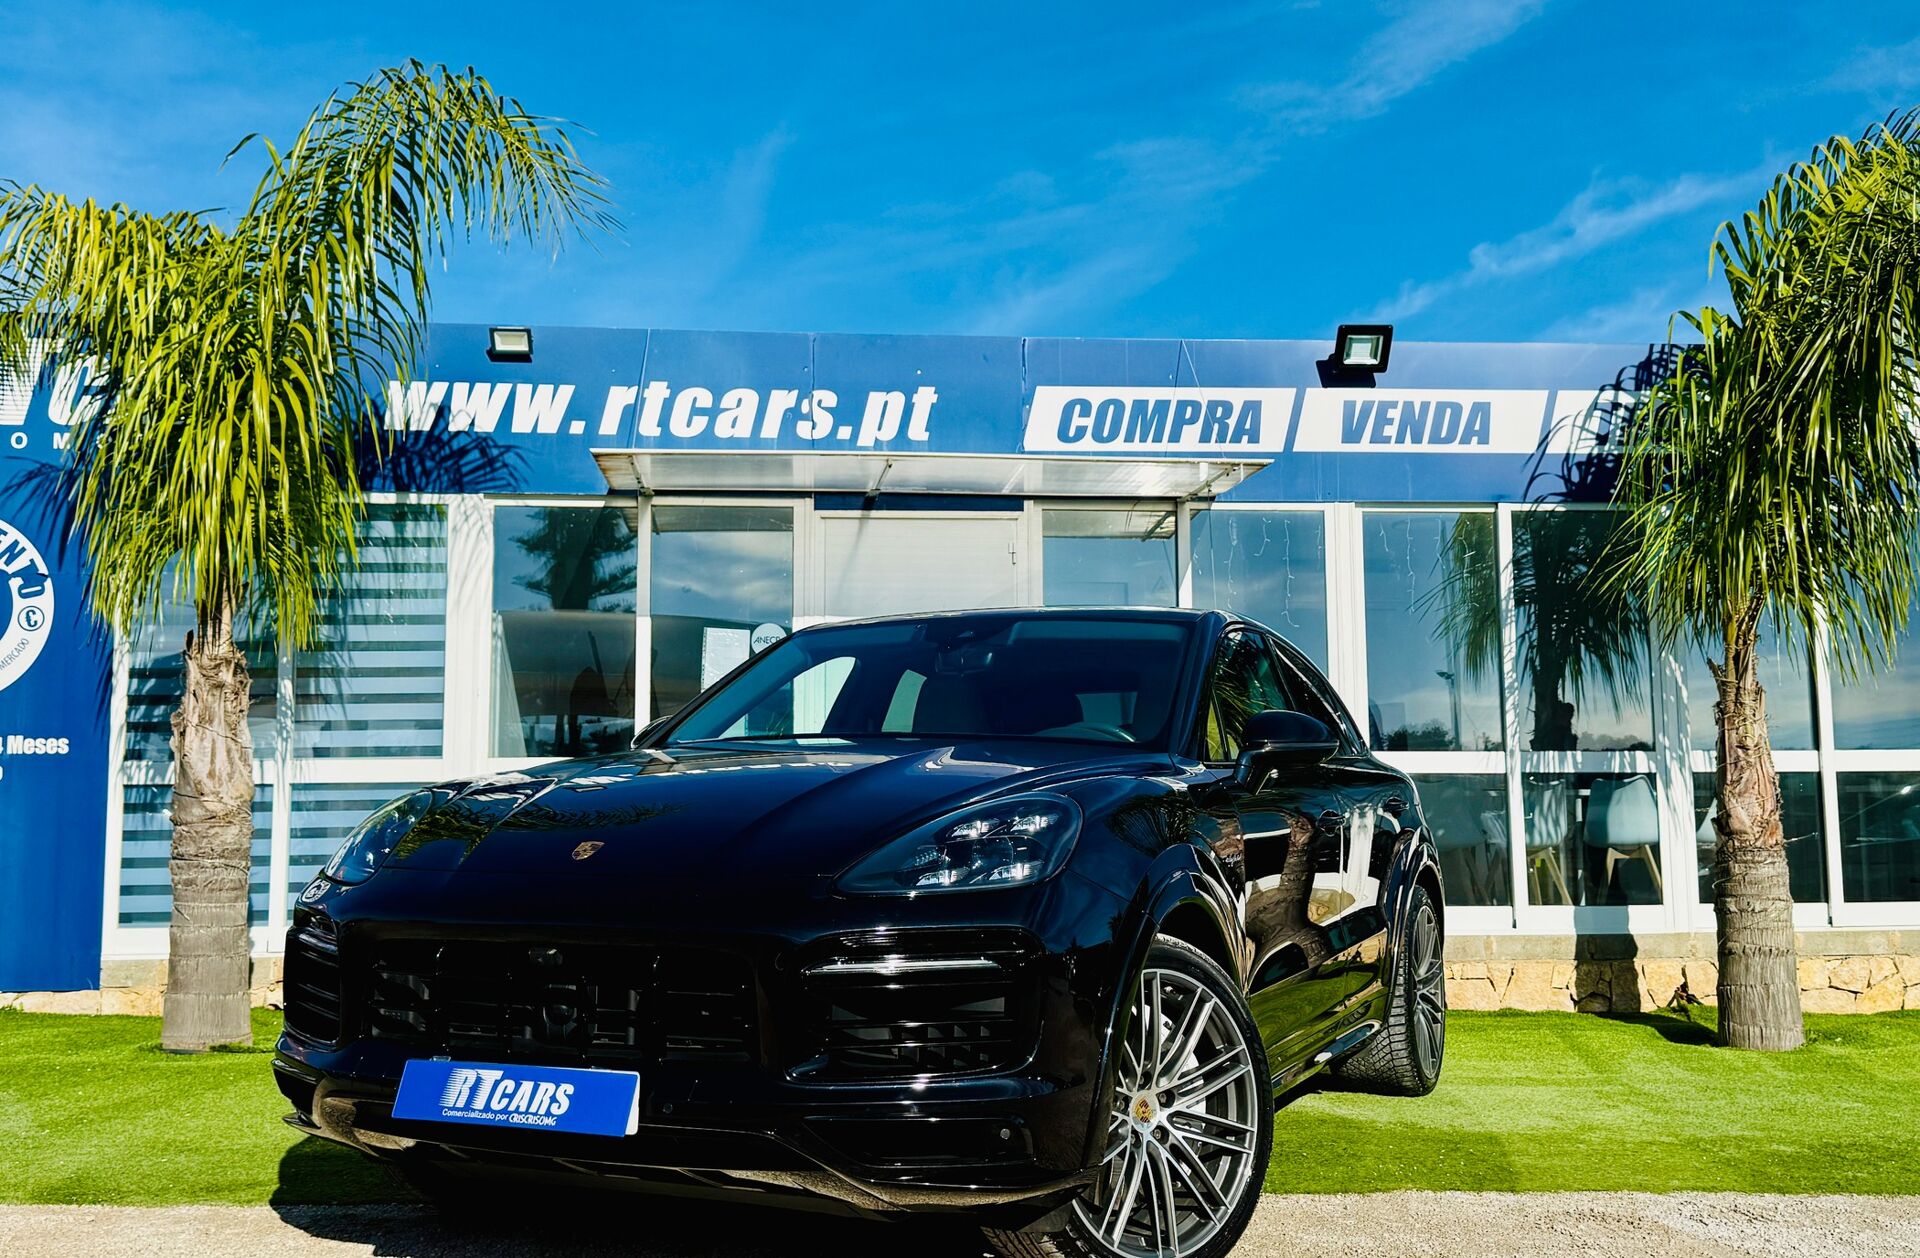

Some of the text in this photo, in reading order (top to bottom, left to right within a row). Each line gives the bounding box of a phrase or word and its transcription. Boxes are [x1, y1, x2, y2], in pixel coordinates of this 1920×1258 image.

[384, 380, 938, 447] www.rtcars.pt
[1056, 397, 1263, 445] COMPRA
[1340, 400, 1491, 445] VENDA
[6, 735, 70, 755] Meses
[441, 1108, 495, 1120] Comercializado
